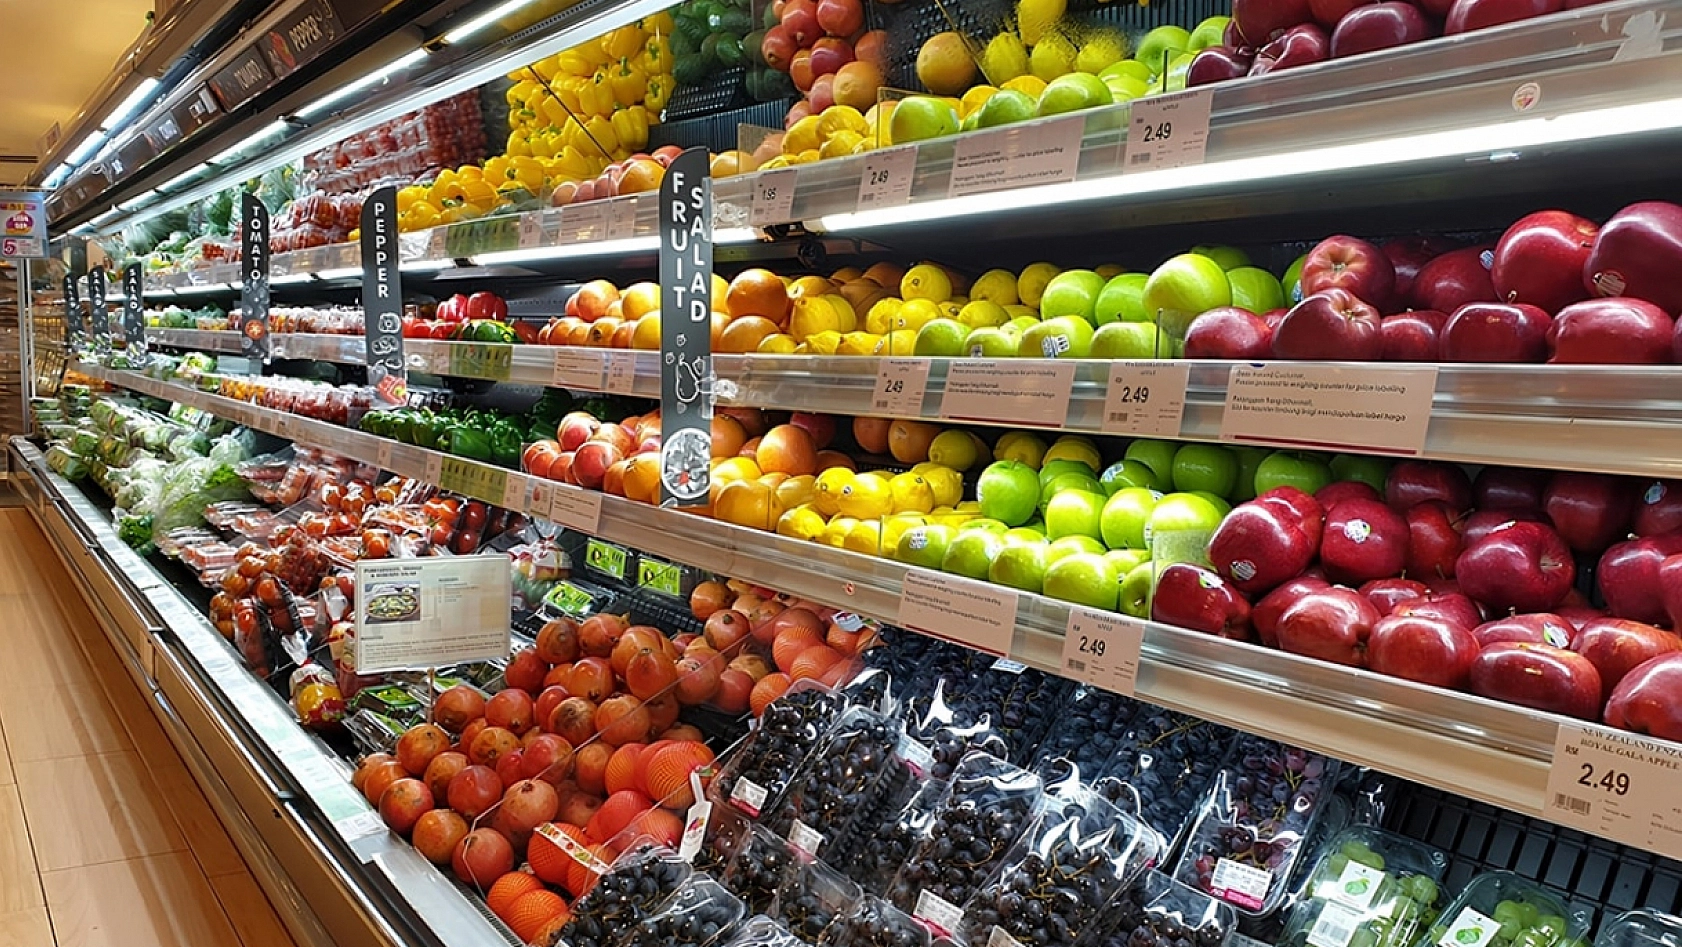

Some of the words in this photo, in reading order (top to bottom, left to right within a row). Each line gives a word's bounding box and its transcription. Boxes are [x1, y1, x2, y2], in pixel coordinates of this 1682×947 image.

[1143, 122, 1172, 142] 2.49
[870, 170, 889, 185] 2.49
[249, 206, 262, 280] TOMATO
[373, 202, 389, 298] PEPPER
[670, 172, 688, 308] FRUIT
[690, 187, 707, 323] SALAD
[1121, 386, 1150, 403] 2.49
[1079, 635, 1106, 657] 2.49
[1580, 738, 1614, 753] ROYAL
[1616, 748, 1643, 761] GALA
[1647, 757, 1680, 770] APPLE
[1578, 762, 1631, 796] 2.49
